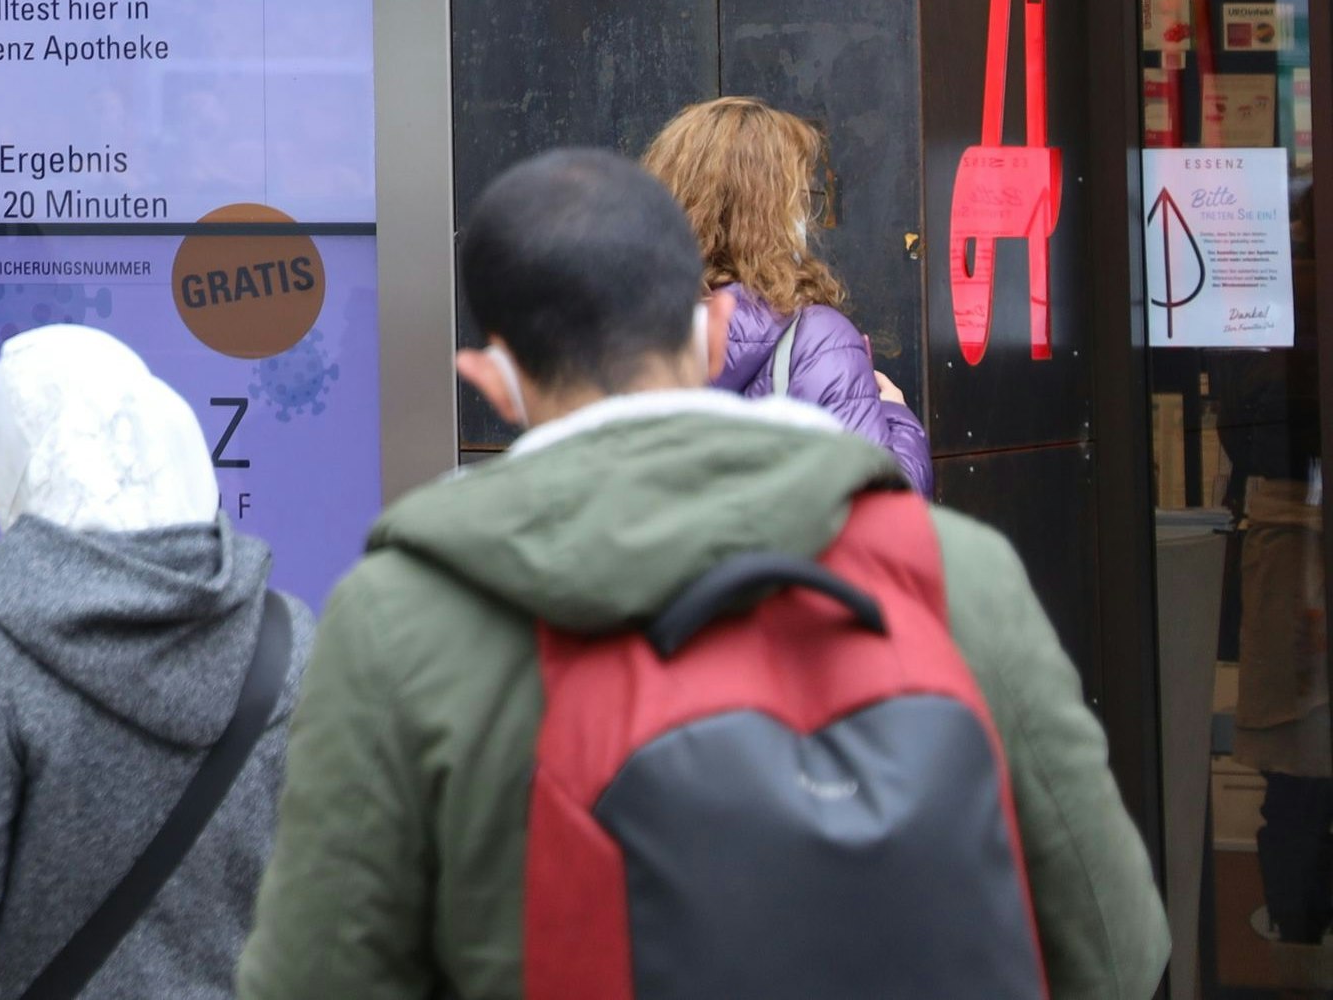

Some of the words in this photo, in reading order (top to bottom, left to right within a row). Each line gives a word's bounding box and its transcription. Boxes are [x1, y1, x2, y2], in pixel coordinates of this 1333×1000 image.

[44, 35, 169, 67] Apotheke
[0, 145, 128, 180] Ergebnis
[1184, 158, 1245, 170] ESSENZ
[3, 190, 35, 219] 20
[46, 190, 168, 219] Minuten
[1190, 186, 1238, 209] Bitte
[181, 256, 316, 309] GRATIS
